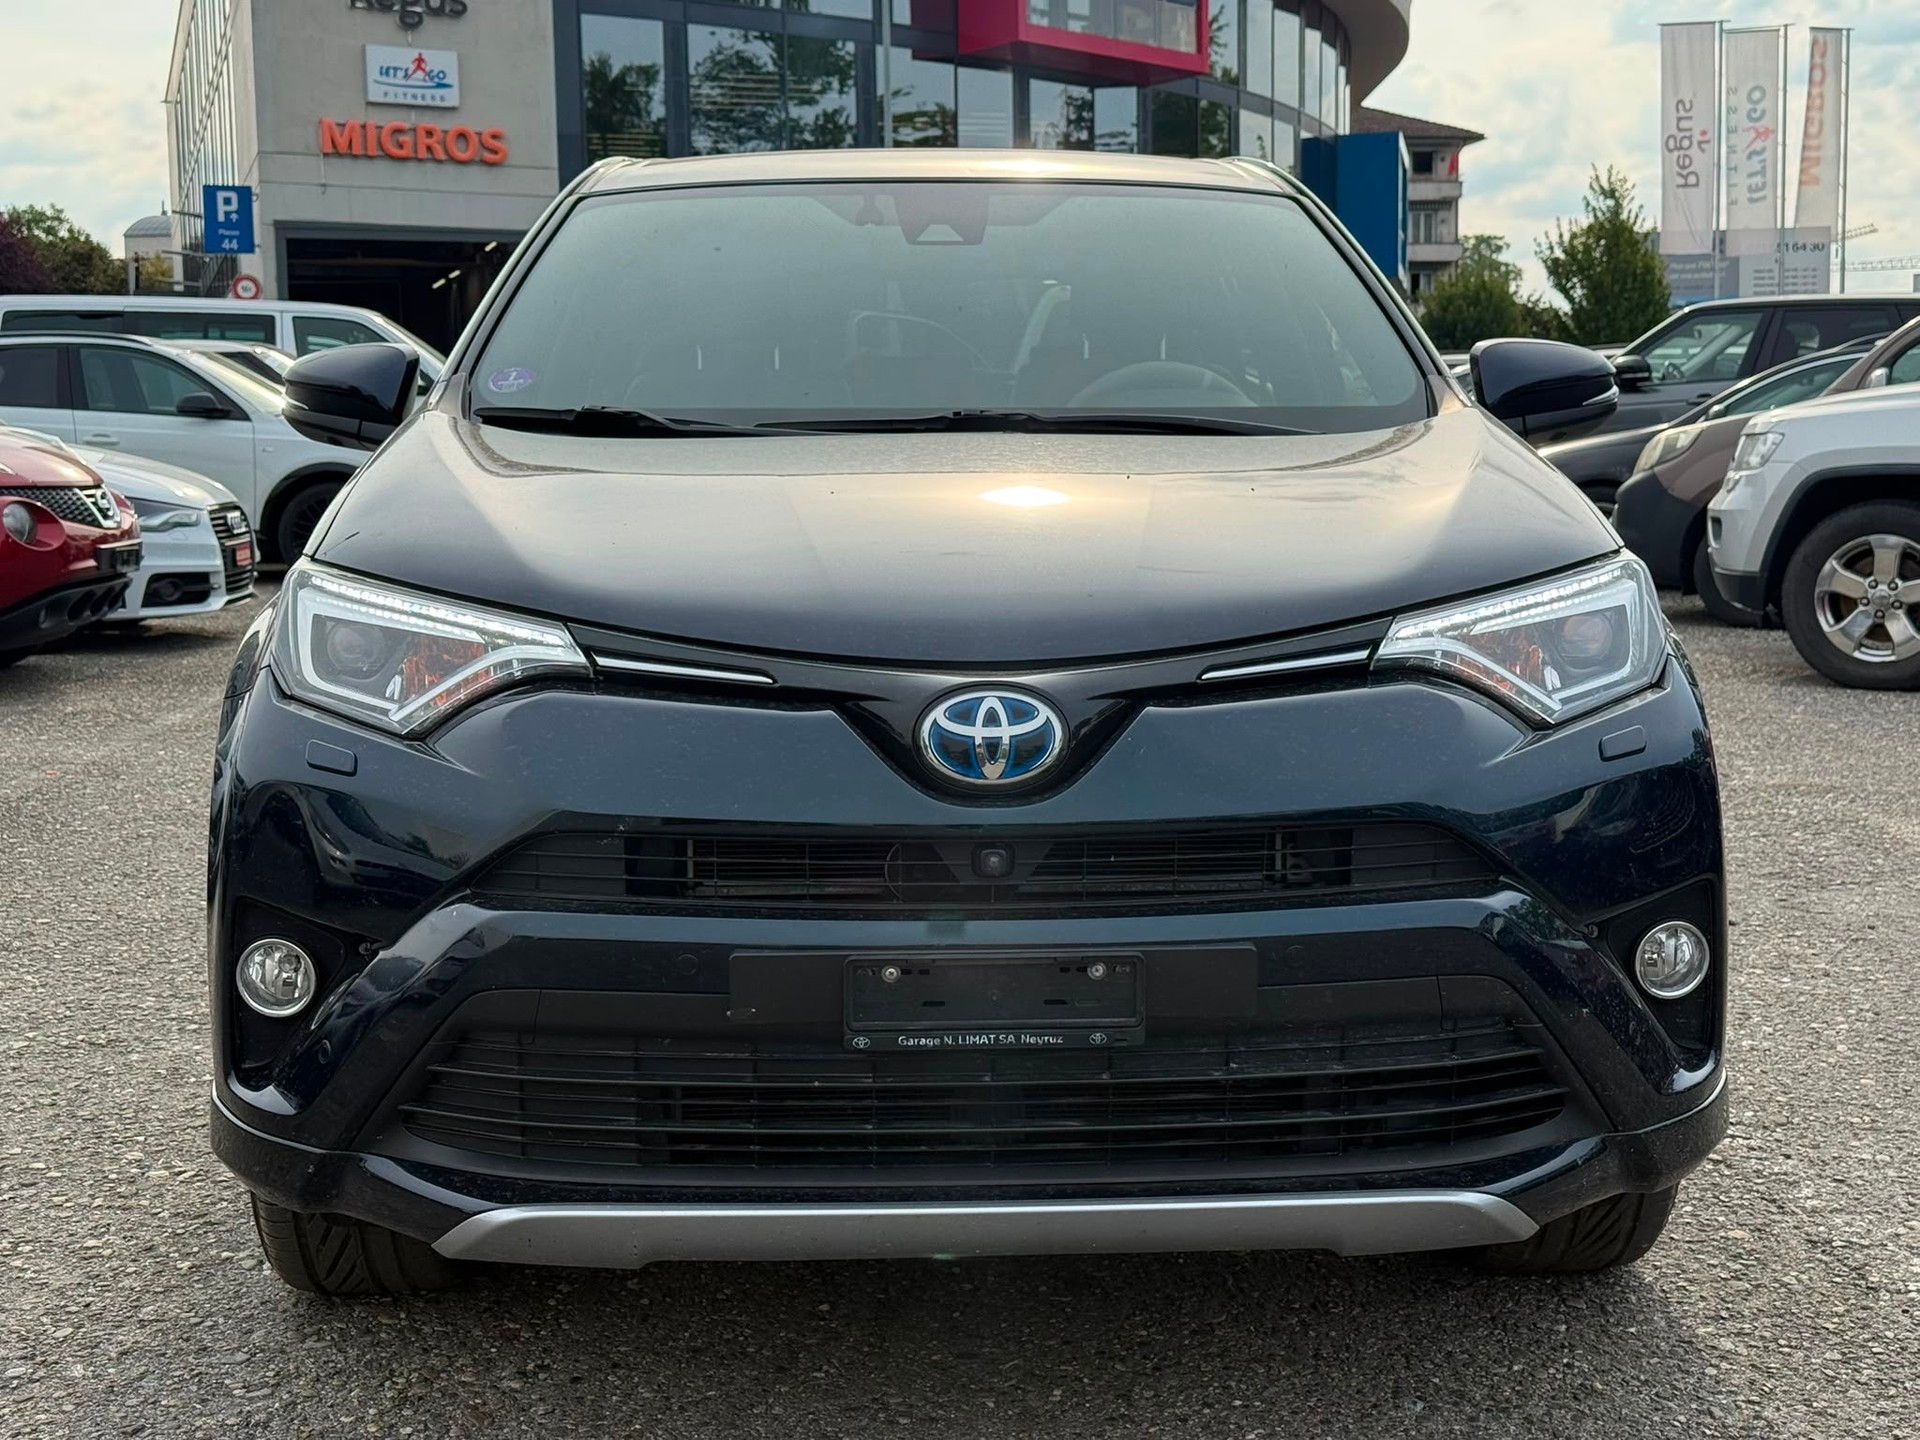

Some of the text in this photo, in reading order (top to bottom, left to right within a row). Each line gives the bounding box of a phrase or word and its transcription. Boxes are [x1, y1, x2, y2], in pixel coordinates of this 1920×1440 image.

[379, 65, 447, 82] LET'S GO
[383, 91, 447, 102] FITNESS
[320, 117, 509, 165] MIGROS
[216, 190, 239, 222] P
[221, 238, 239, 250] 44
[898, 1034, 1064, 1047] Garage N. LIMAT SA Neyruz
